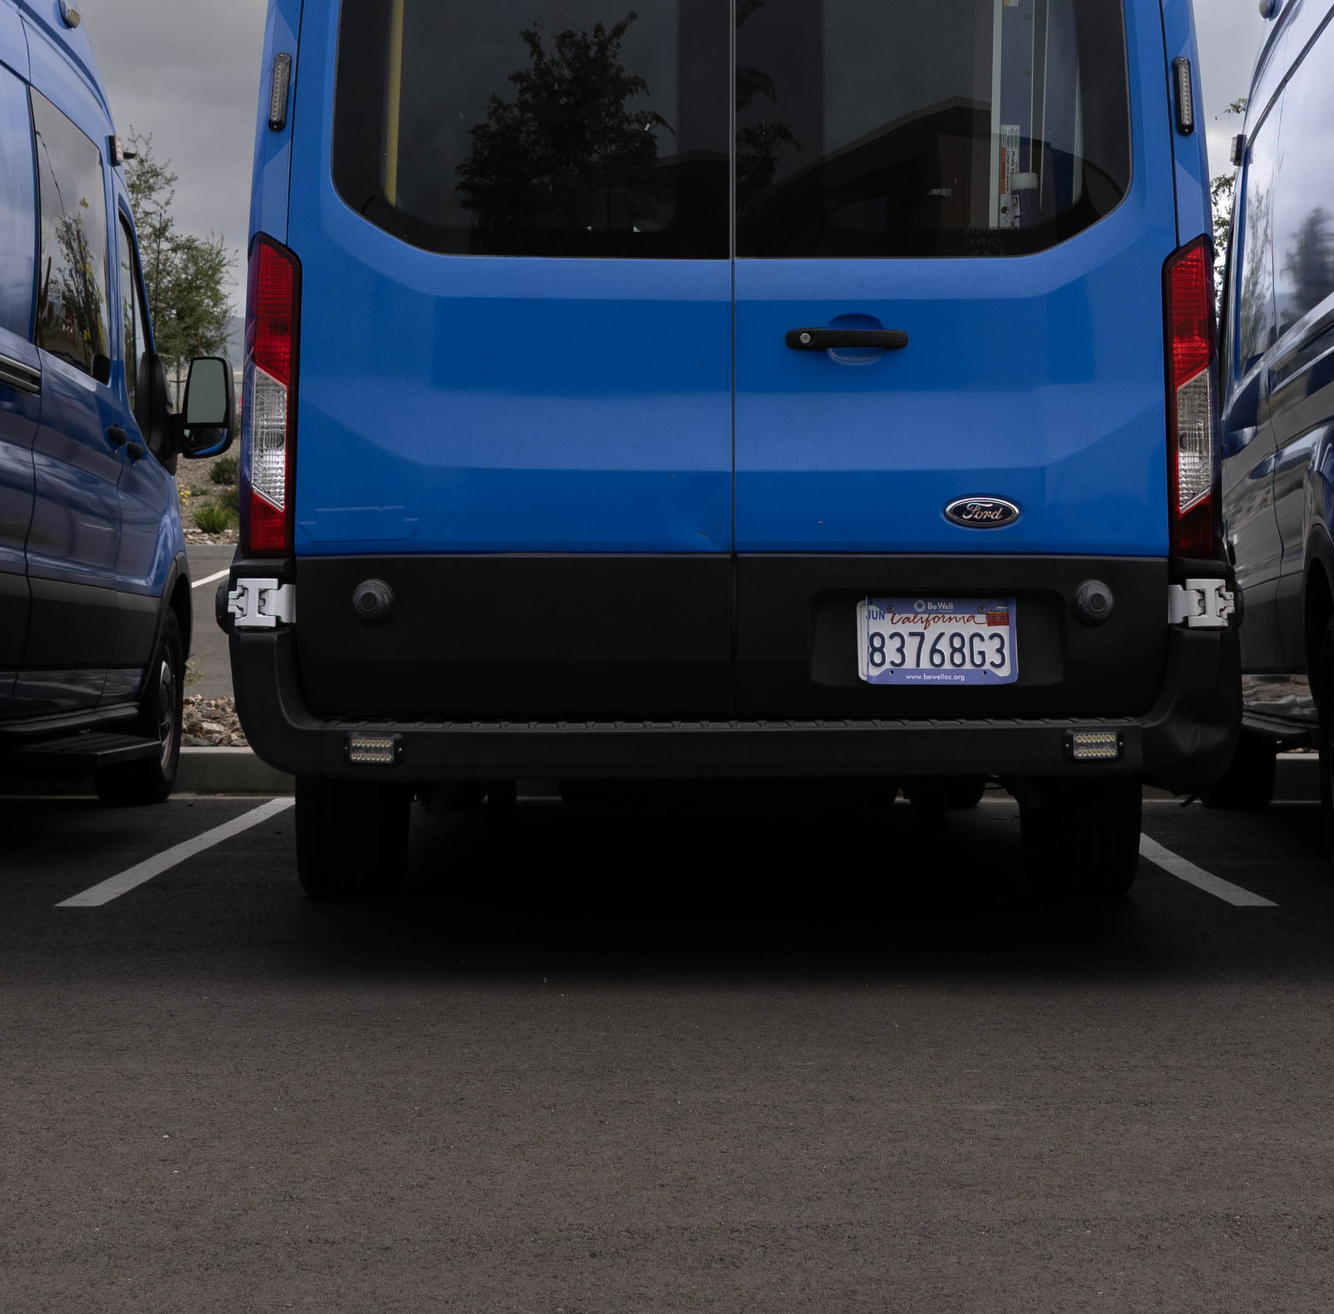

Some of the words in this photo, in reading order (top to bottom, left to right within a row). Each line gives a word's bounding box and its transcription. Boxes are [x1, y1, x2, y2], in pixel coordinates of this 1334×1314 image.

[962, 502, 1003, 519] Ford
[927, 602, 938, 610] Be
[937, 602, 954, 610] Well
[866, 609, 885, 621] JUN
[890, 613, 987, 631] California
[869, 631, 1006, 668] 83768G3
[905, 673, 966, 682] www.bewelloc.org
